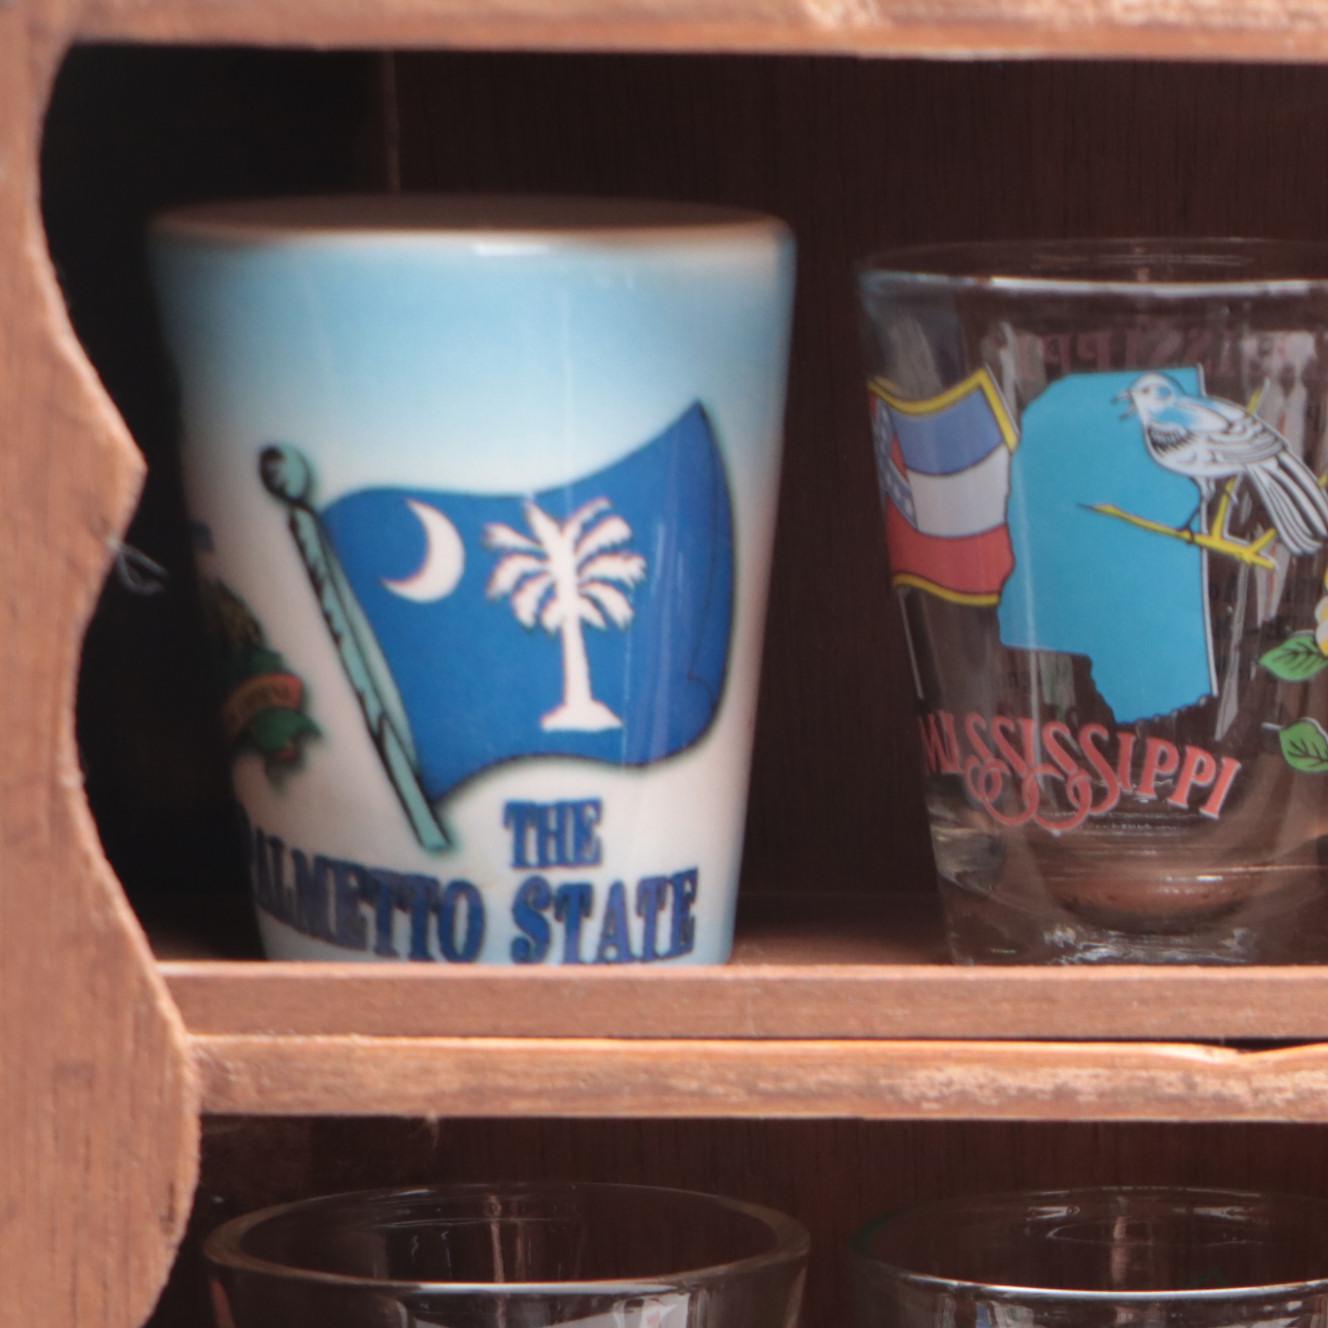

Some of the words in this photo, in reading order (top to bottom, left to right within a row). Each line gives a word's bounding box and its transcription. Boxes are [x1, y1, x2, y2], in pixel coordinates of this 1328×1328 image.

[919, 709, 1241, 832] MISSISSIPPI
[504, 798, 604, 869] THE
[252, 826, 485, 964] ALMETTO
[509, 868, 699, 965] STATE
